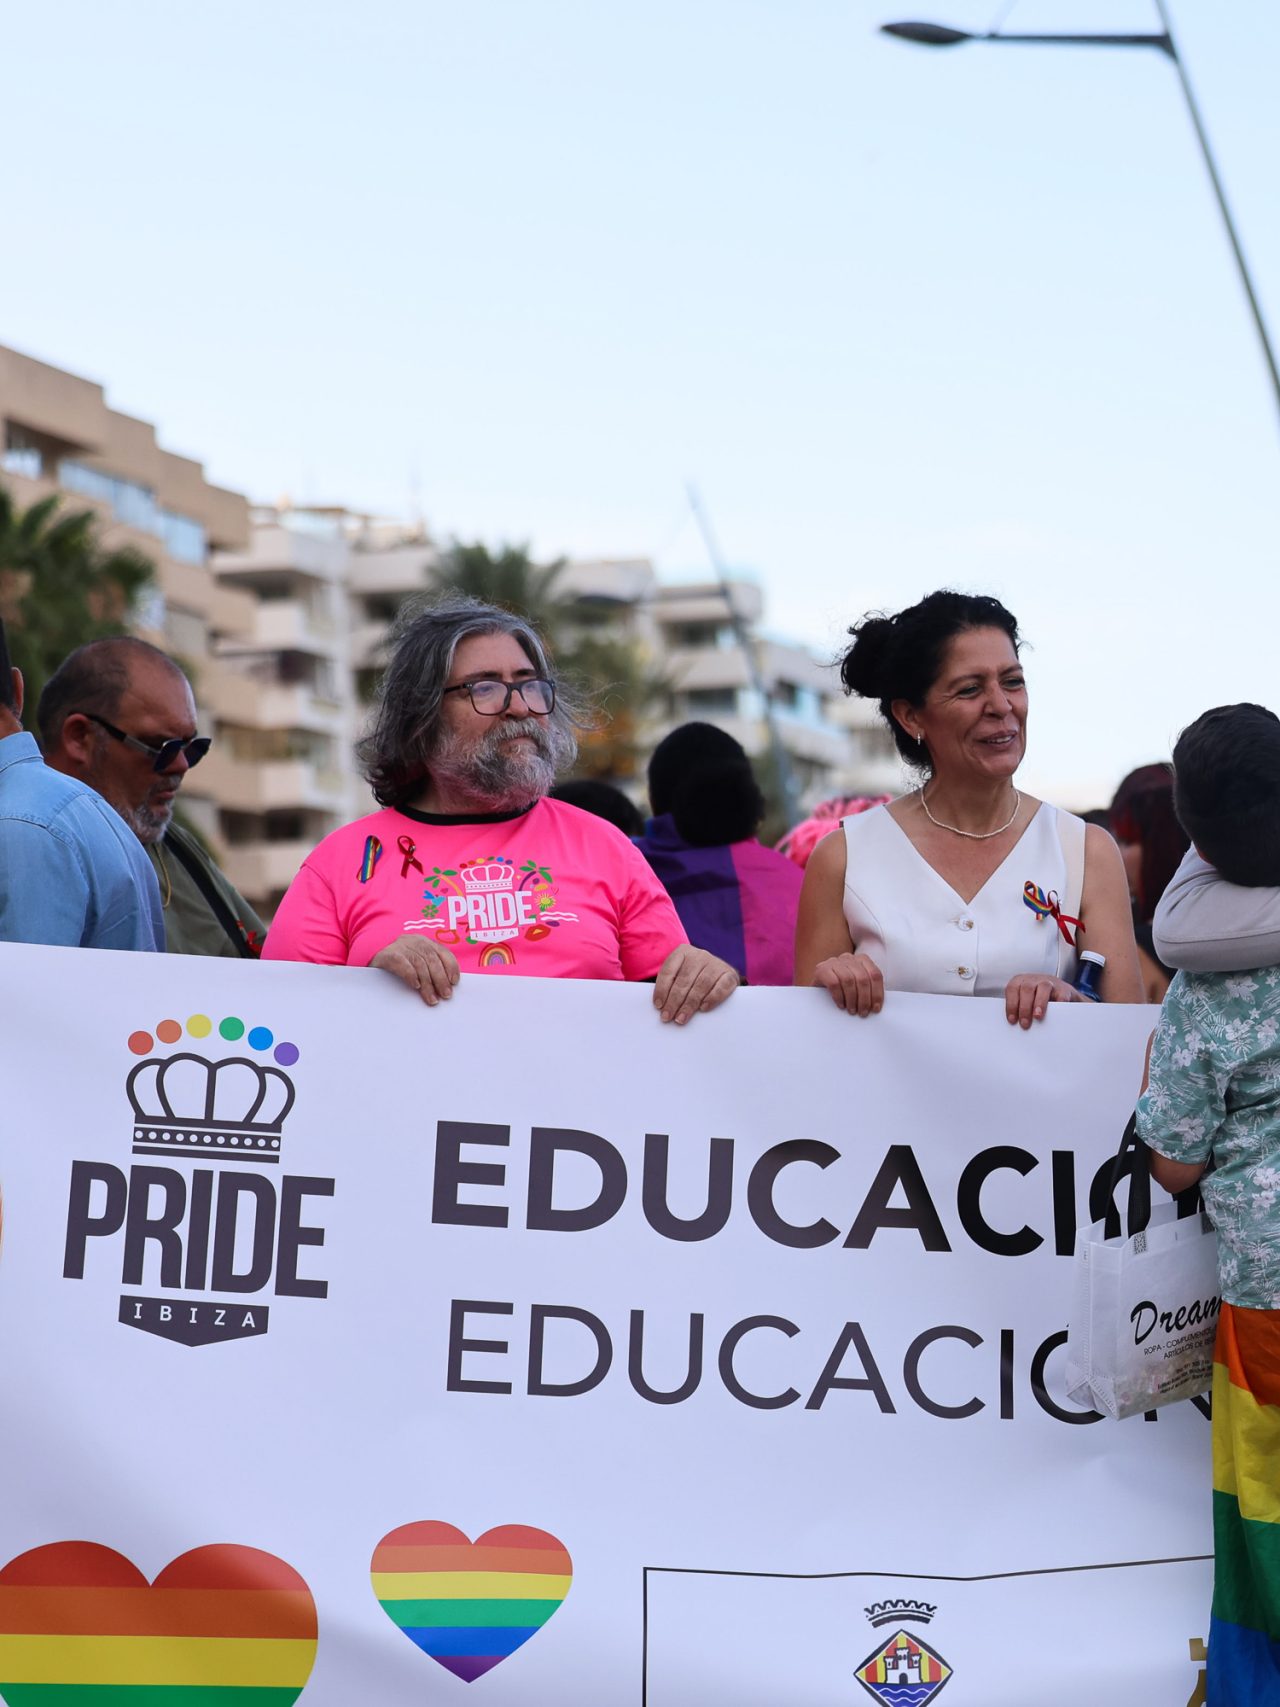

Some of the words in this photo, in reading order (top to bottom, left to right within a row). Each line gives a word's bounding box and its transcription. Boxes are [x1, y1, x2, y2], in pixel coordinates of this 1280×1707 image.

[448, 890, 536, 930] PRIDE
[63, 1160, 335, 1299] PRIDE
[134, 1302, 256, 1328] IBIZA
[1144, 1344, 1162, 1356] ROPA
